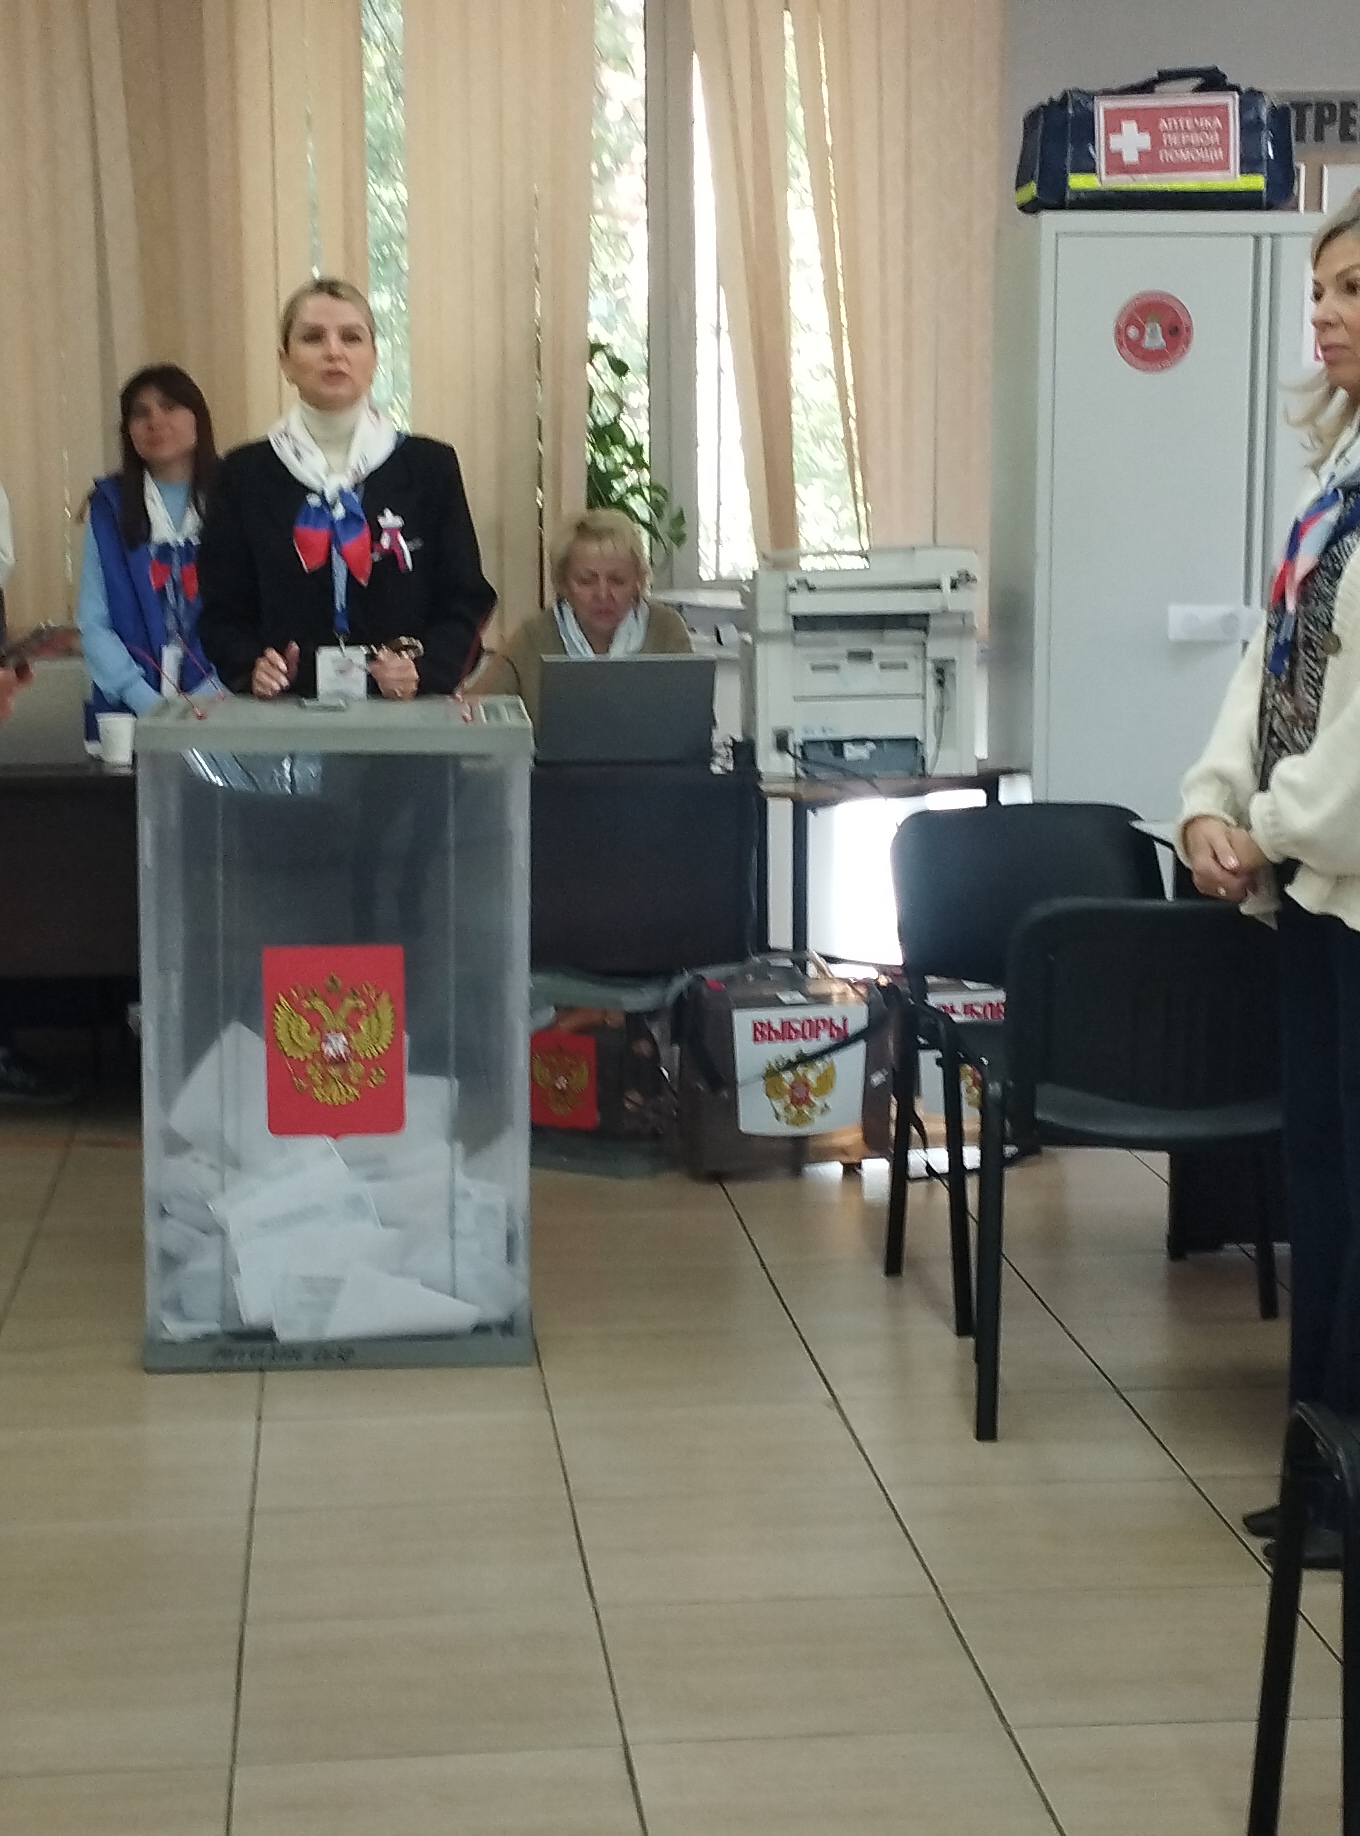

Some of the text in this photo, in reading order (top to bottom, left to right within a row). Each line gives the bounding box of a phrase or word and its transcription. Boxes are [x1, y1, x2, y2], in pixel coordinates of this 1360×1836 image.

[1158, 115, 1223, 131] АПТЕЧКА
[1162, 131, 1220, 147] ПЕРВОЙ
[1158, 147, 1224, 164] ПОМОЩИ
[751, 1016, 850, 1042] ВЫБОРЫ
